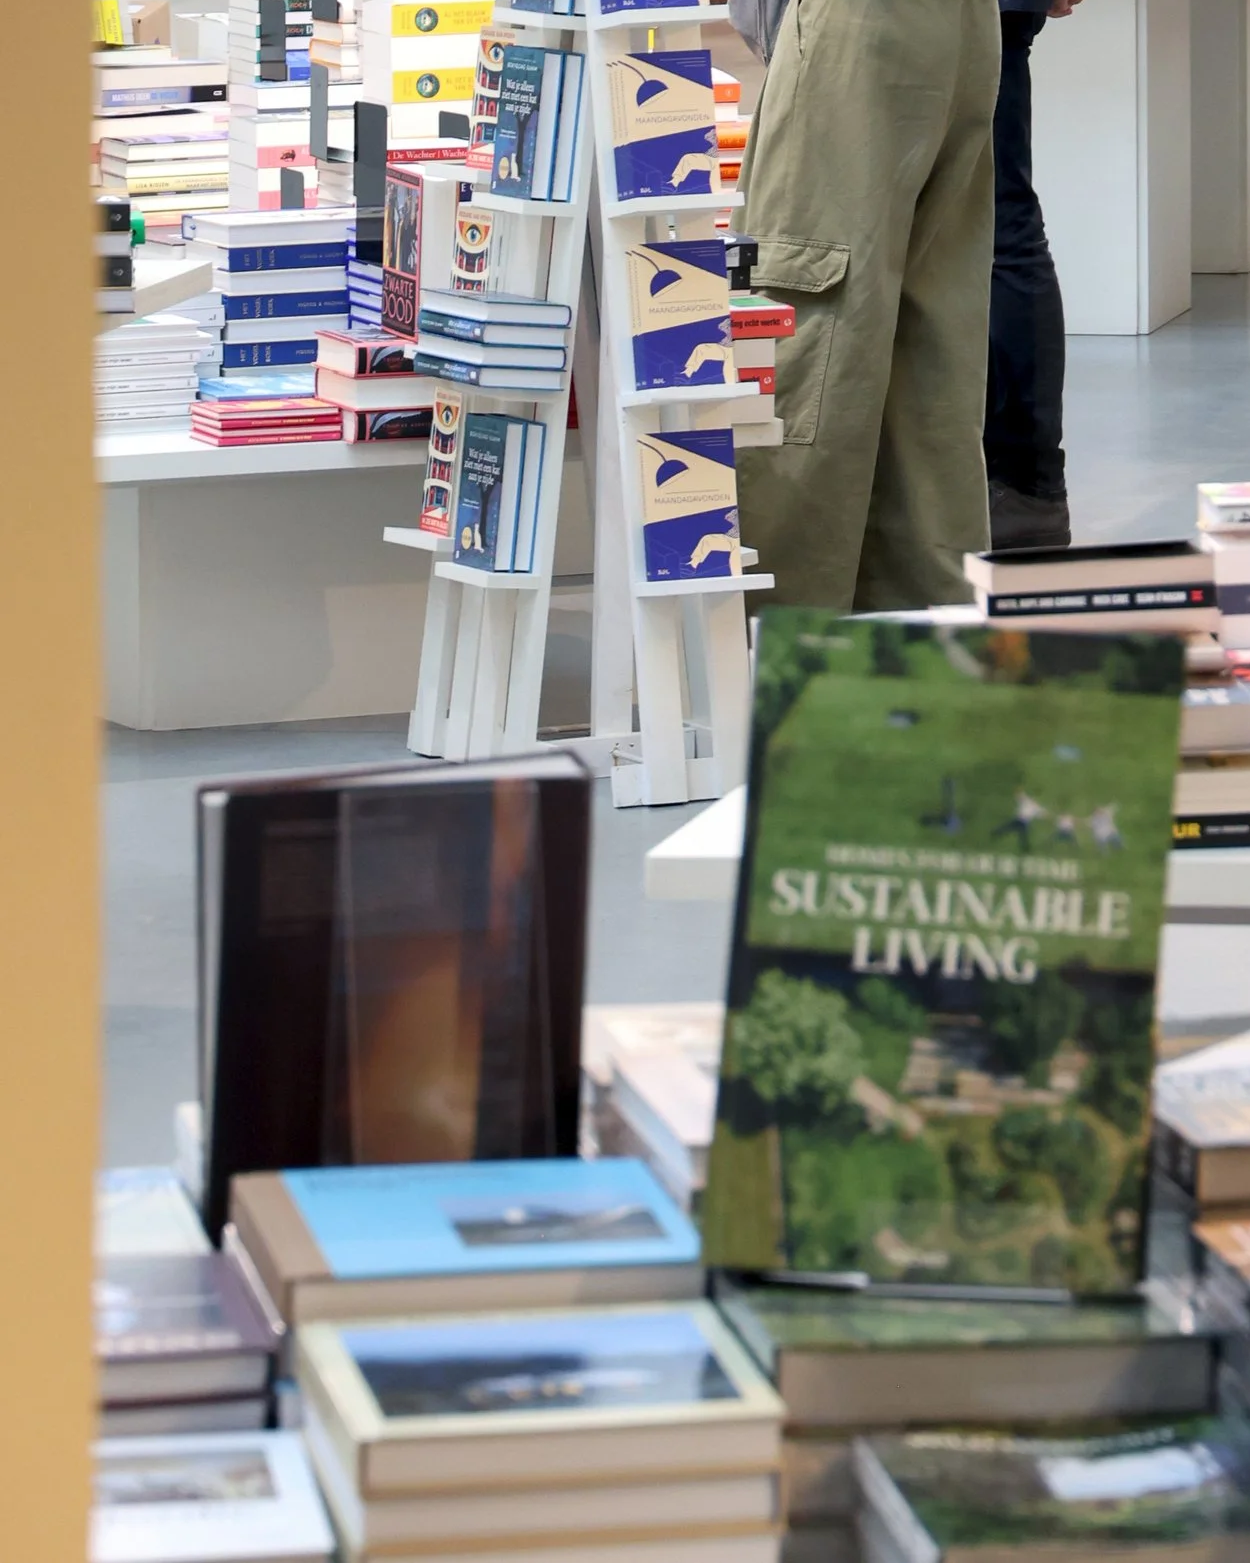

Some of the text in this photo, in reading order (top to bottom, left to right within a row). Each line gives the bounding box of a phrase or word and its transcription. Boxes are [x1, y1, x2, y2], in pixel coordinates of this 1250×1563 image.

[635, 113, 711, 126] MAANDAGAVONDEN
[406, 149, 436, 160] Wachter
[384, 274, 415, 299] ZWARTE
[648, 303, 724, 314] MAANDAGAVONDEN
[760, 317, 781, 327] werkt
[654, 492, 731, 505] MAANDAGAVONDEN
[769, 868, 1133, 938] SUSTAINABLE
[851, 925, 1040, 986] LIVING
